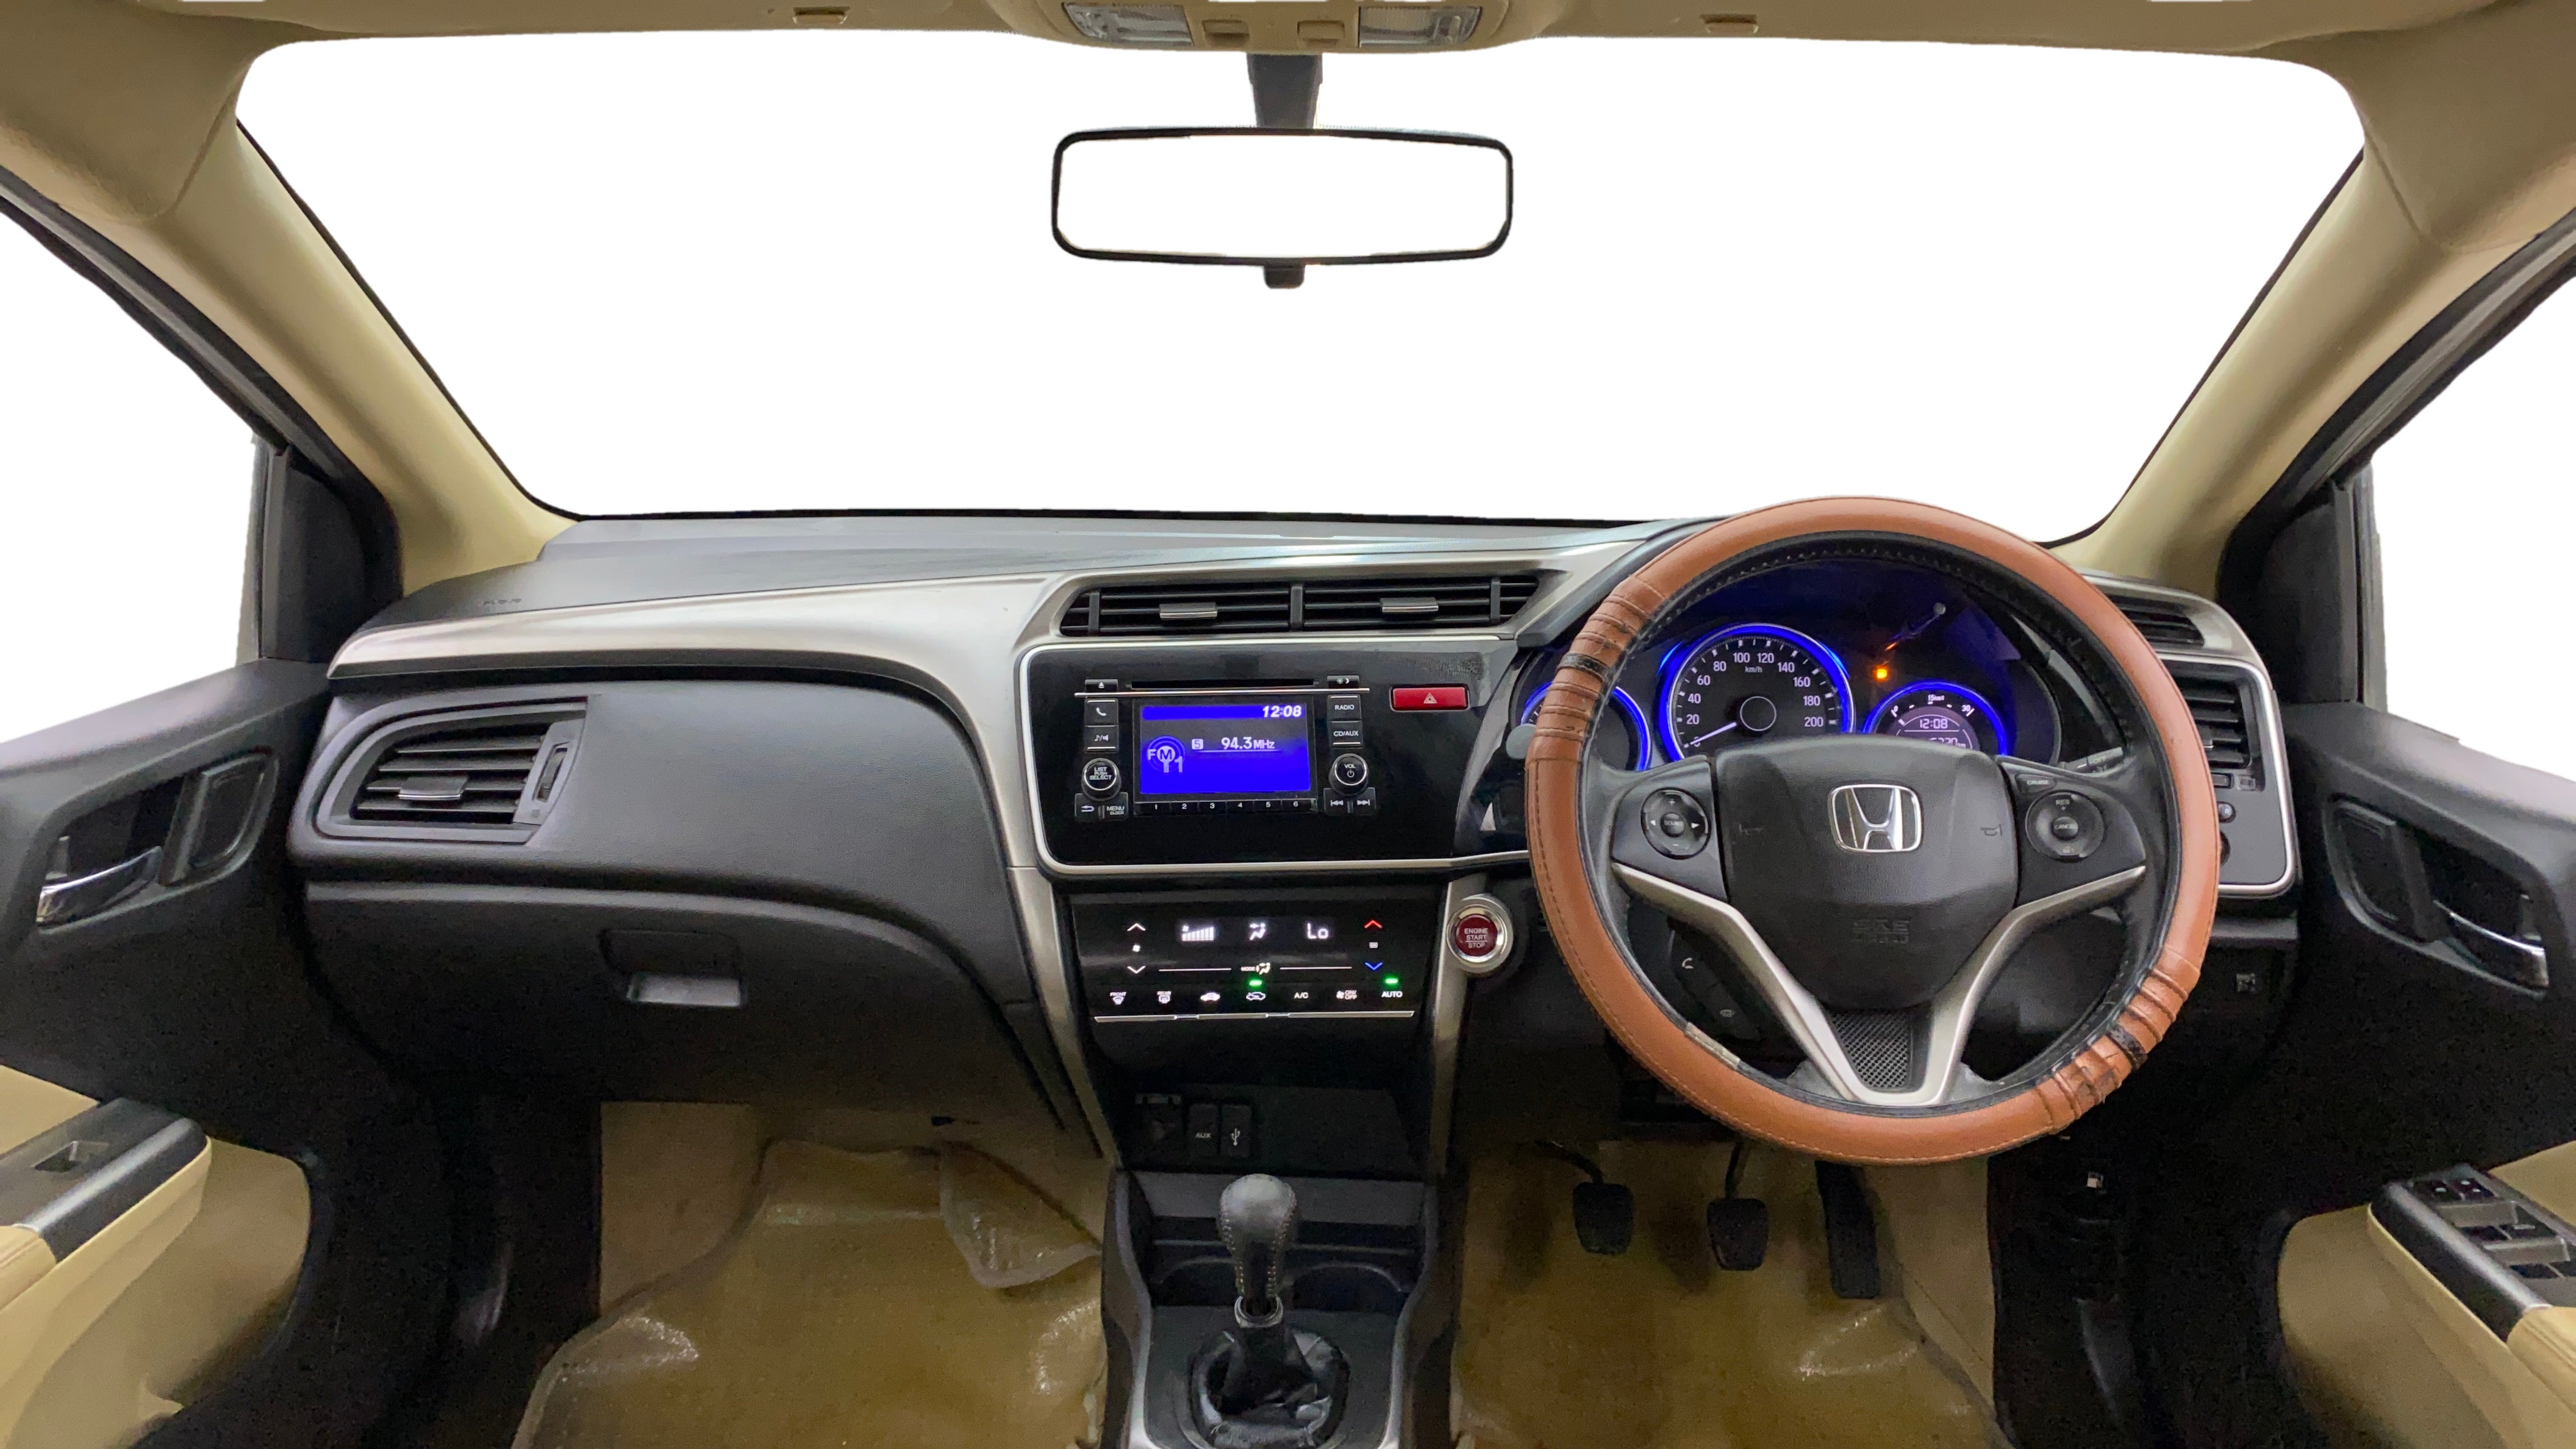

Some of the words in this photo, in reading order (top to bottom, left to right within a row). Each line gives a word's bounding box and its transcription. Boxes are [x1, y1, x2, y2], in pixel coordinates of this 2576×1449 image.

[1733, 653, 1750, 663] 100
[1757, 653, 1774, 664] 120
[1713, 660, 1726, 672] 80
[1778, 662, 1795, 673] 140
[1697, 674, 1711, 686] 60
[1793, 676, 1811, 688] 160
[1687, 693, 1701, 704] 40
[1803, 695, 1820, 706] 180
[1262, 705, 1302, 718] 12:08
[1686, 714, 1700, 725] 20
[1805, 717, 1823, 728] 200
[1919, 718, 1948, 729] 12:08
[1221, 737, 1252, 750] 94.3
[1253, 740, 1275, 749] MHz
[1307, 922, 1329, 939] Lo
